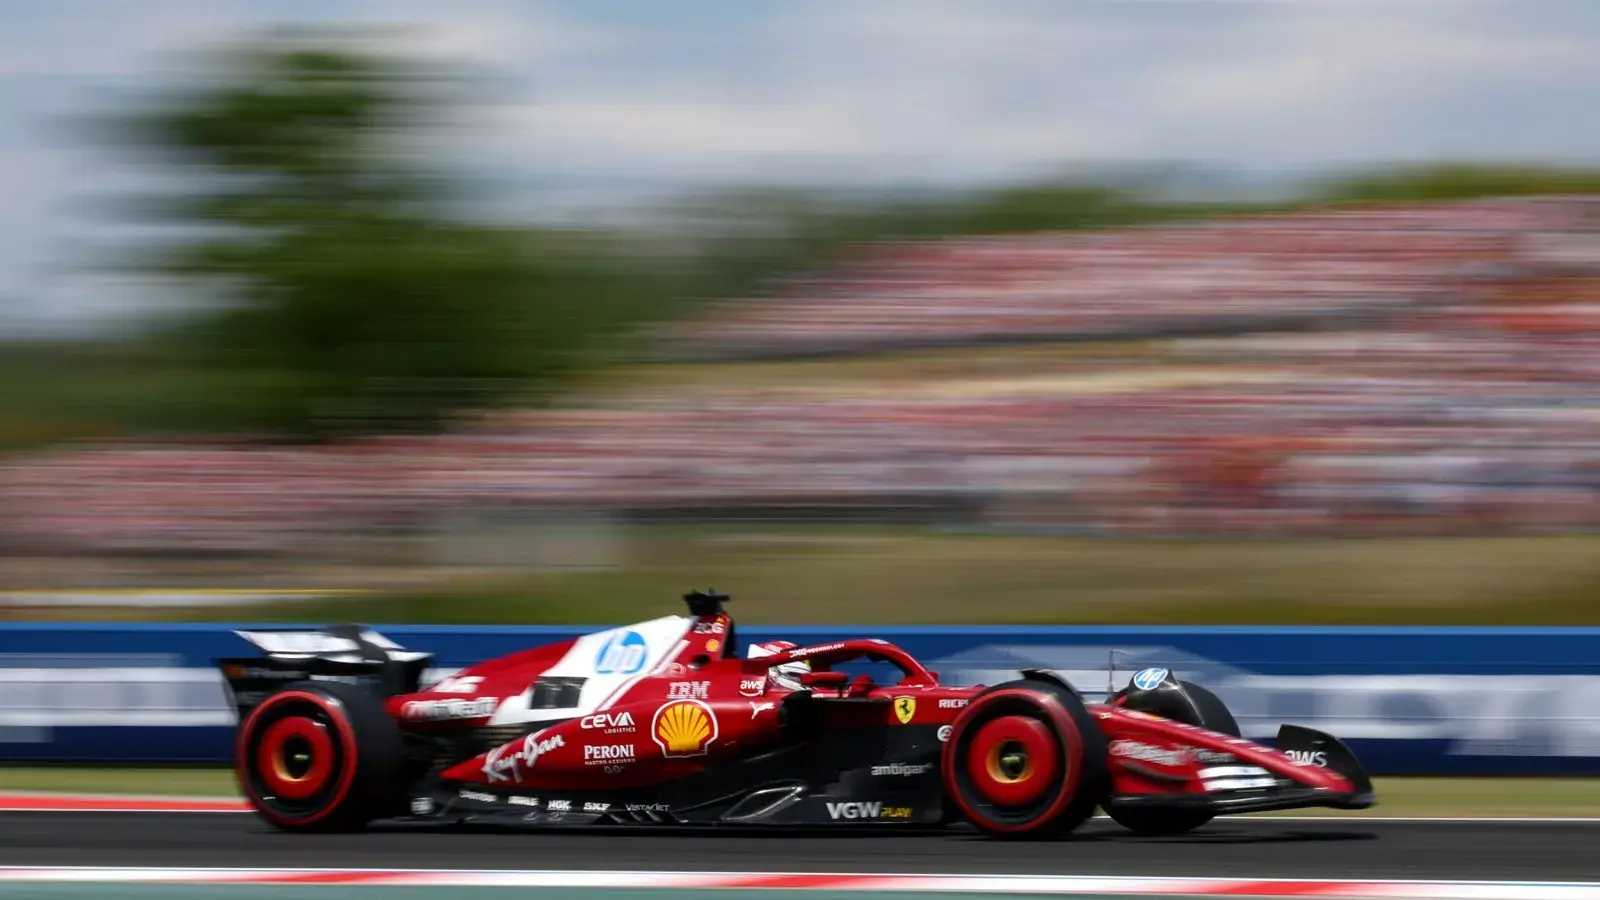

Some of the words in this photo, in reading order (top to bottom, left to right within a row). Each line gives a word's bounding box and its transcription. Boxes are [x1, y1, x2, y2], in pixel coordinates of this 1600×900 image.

[740, 680, 764, 692] aws
[1134, 667, 1169, 690] hp
[666, 681, 712, 699] IBM
[481, 729, 566, 783] Ray-Ban
[584, 744, 635, 760] PERONI
[547, 800, 572, 811] NGK
[583, 802, 611, 812] SKF
[825, 801, 882, 820] VGW
